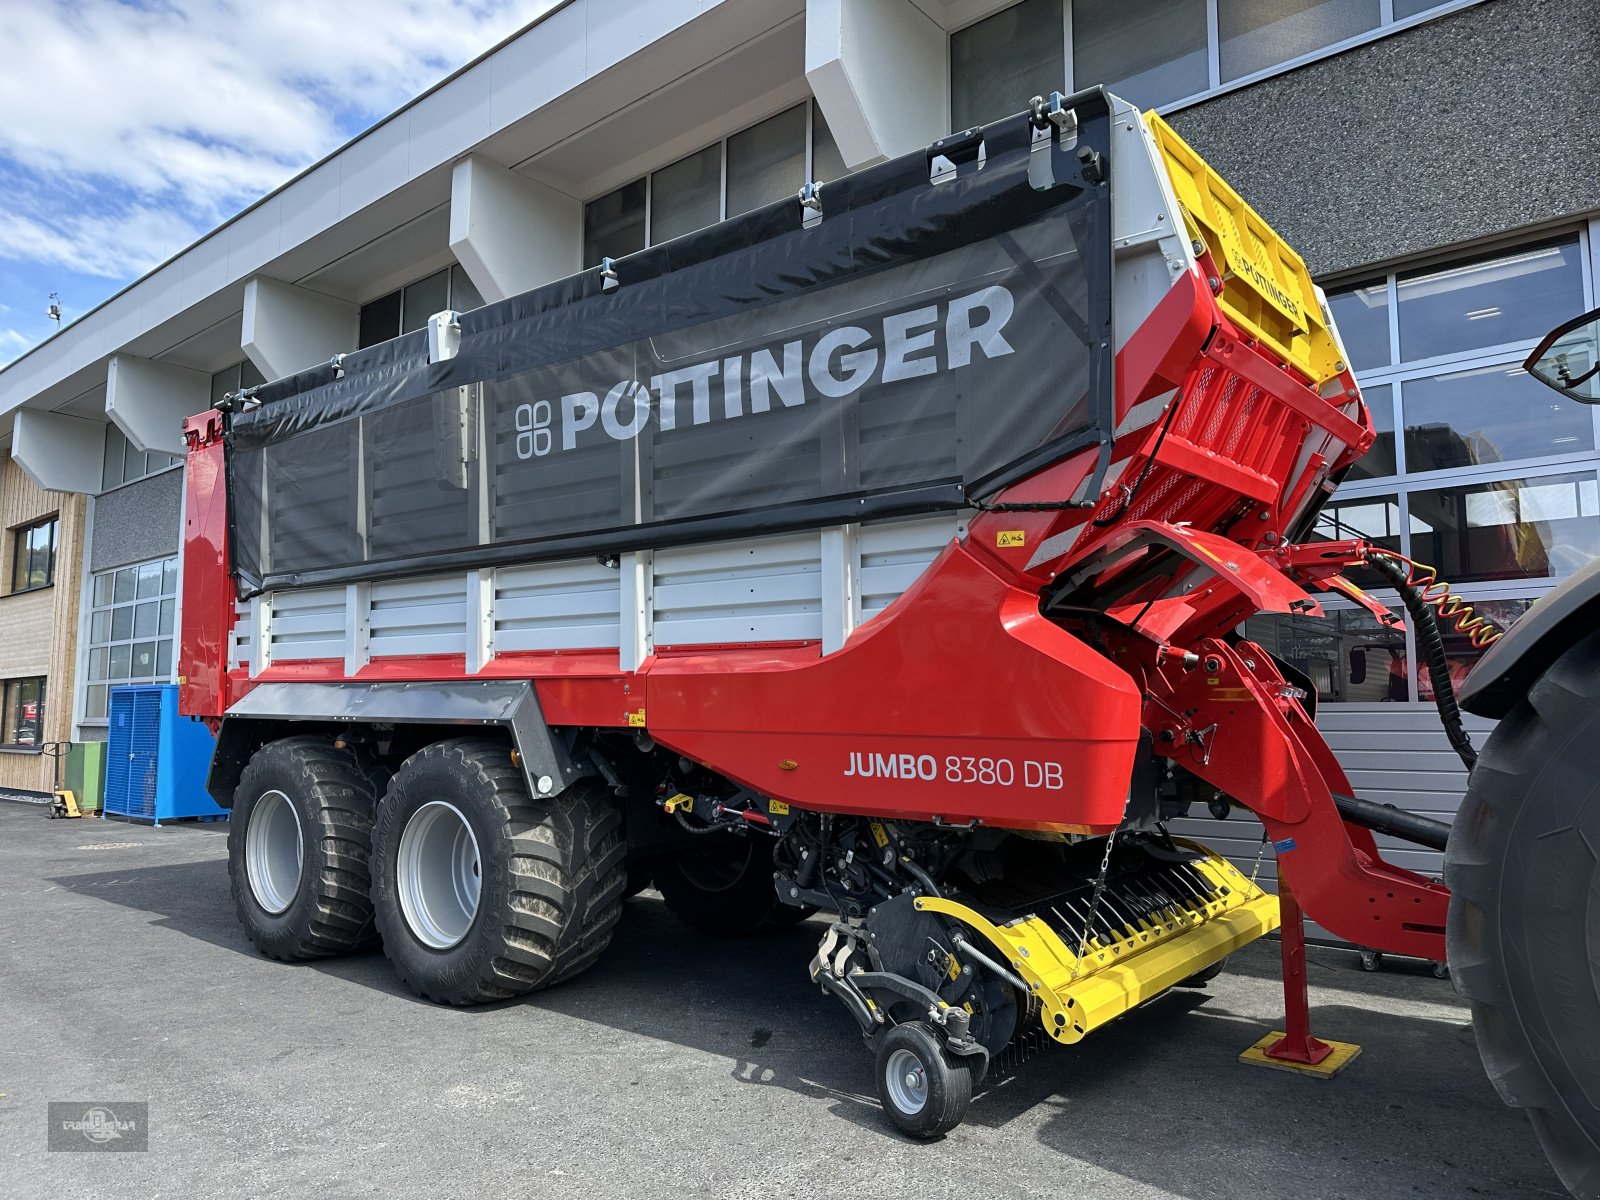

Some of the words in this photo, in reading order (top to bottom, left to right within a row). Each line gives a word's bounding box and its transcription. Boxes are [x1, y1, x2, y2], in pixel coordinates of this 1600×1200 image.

[844, 752, 937, 780] JUMBO
[945, 756, 1014, 786] 8380
[1023, 760, 1064, 790] DB
